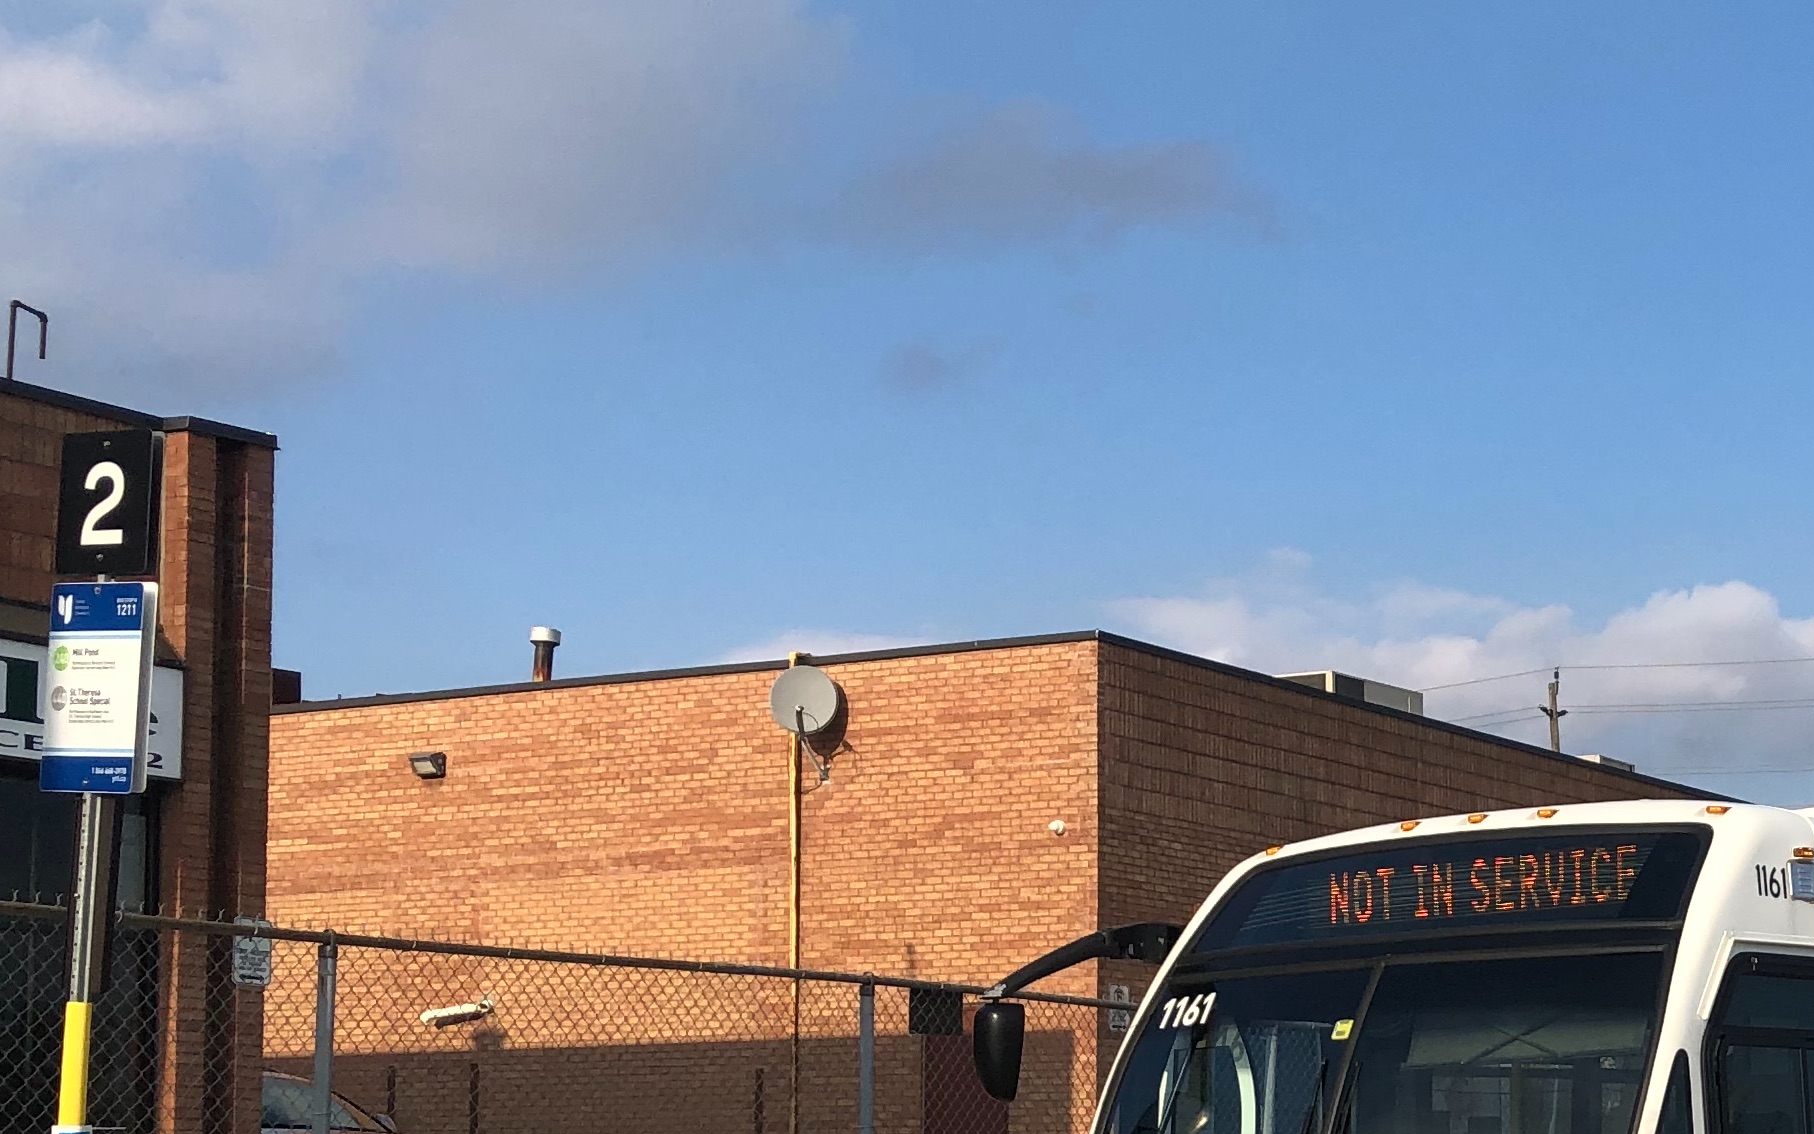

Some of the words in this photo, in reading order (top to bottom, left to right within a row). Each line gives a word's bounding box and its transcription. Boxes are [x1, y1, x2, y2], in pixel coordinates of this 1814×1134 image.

[80, 461, 125, 546] 2
[117, 603, 137, 616] 1211
[1330, 867, 1395, 924] NOT
[1413, 863, 1453, 917] IN
[1469, 844, 1637, 912] SERVICE
[1755, 864, 1787, 899] 1161
[1159, 991, 1217, 1030] 1161
